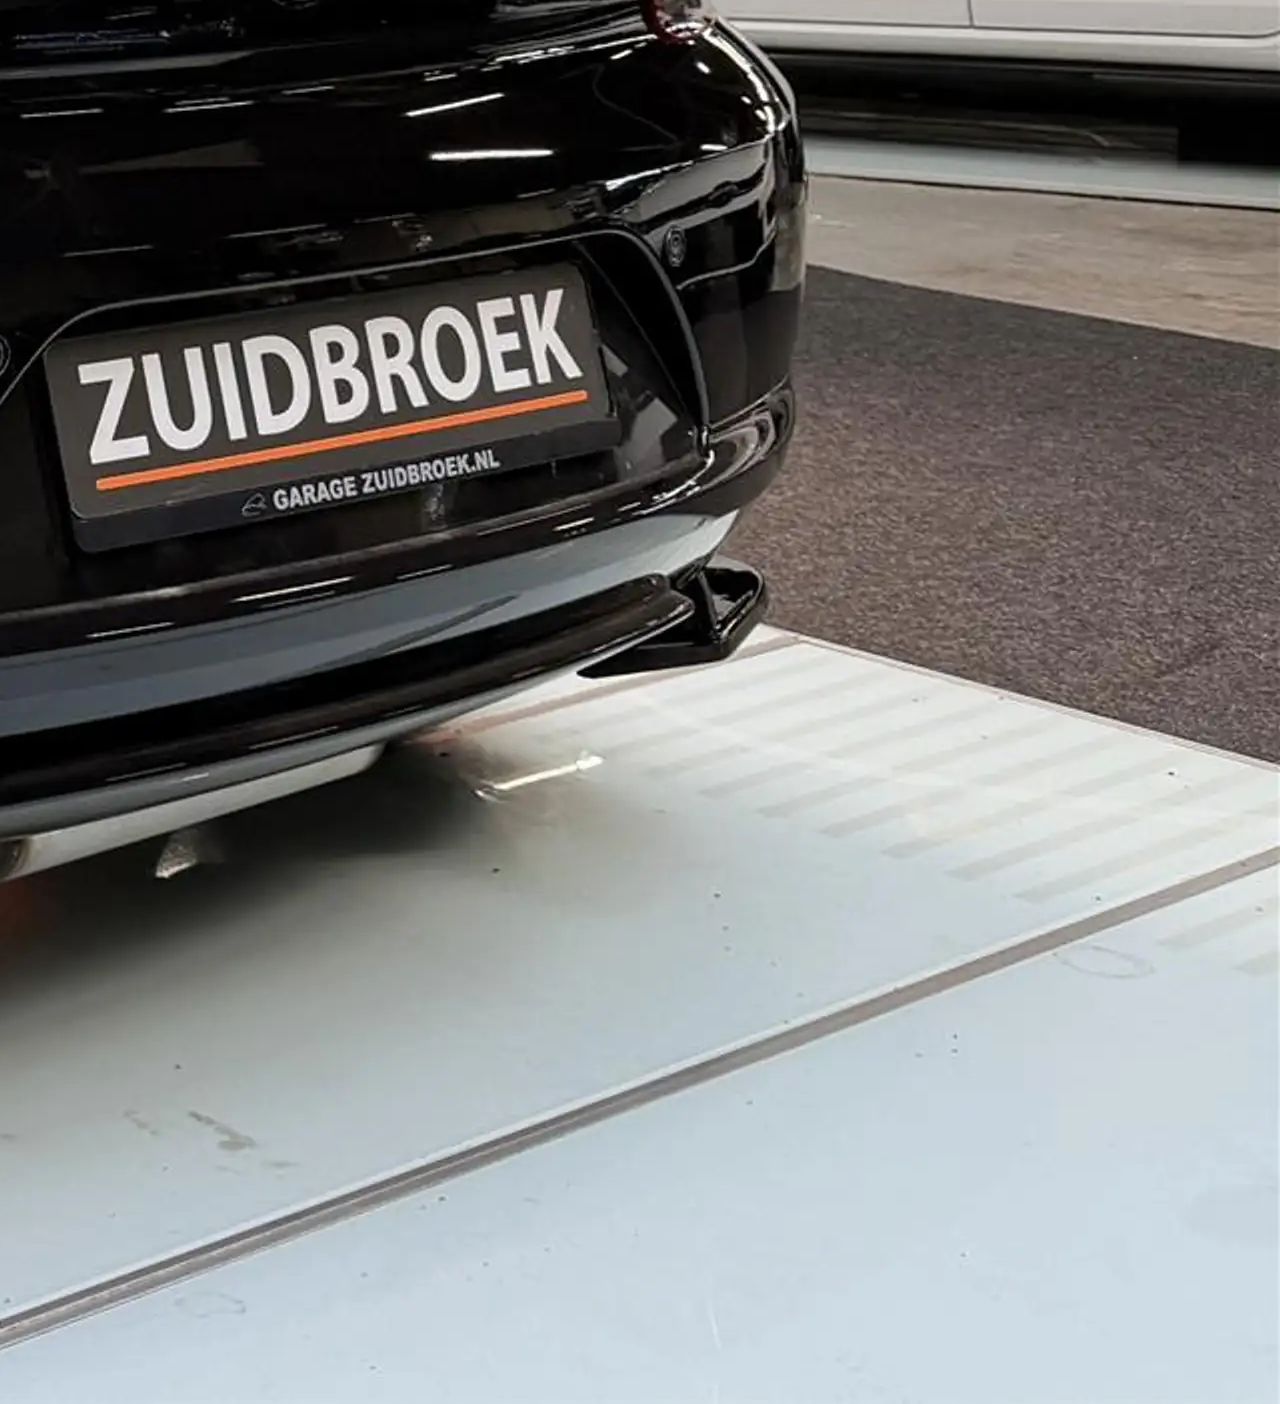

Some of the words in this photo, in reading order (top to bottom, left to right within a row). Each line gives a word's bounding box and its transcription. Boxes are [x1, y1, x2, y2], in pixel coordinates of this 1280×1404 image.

[77, 288, 583, 465] ZUIDBROEK
[272, 474, 357, 511] GARAGE
[361, 448, 501, 493] ZUIDBROEK.NL
